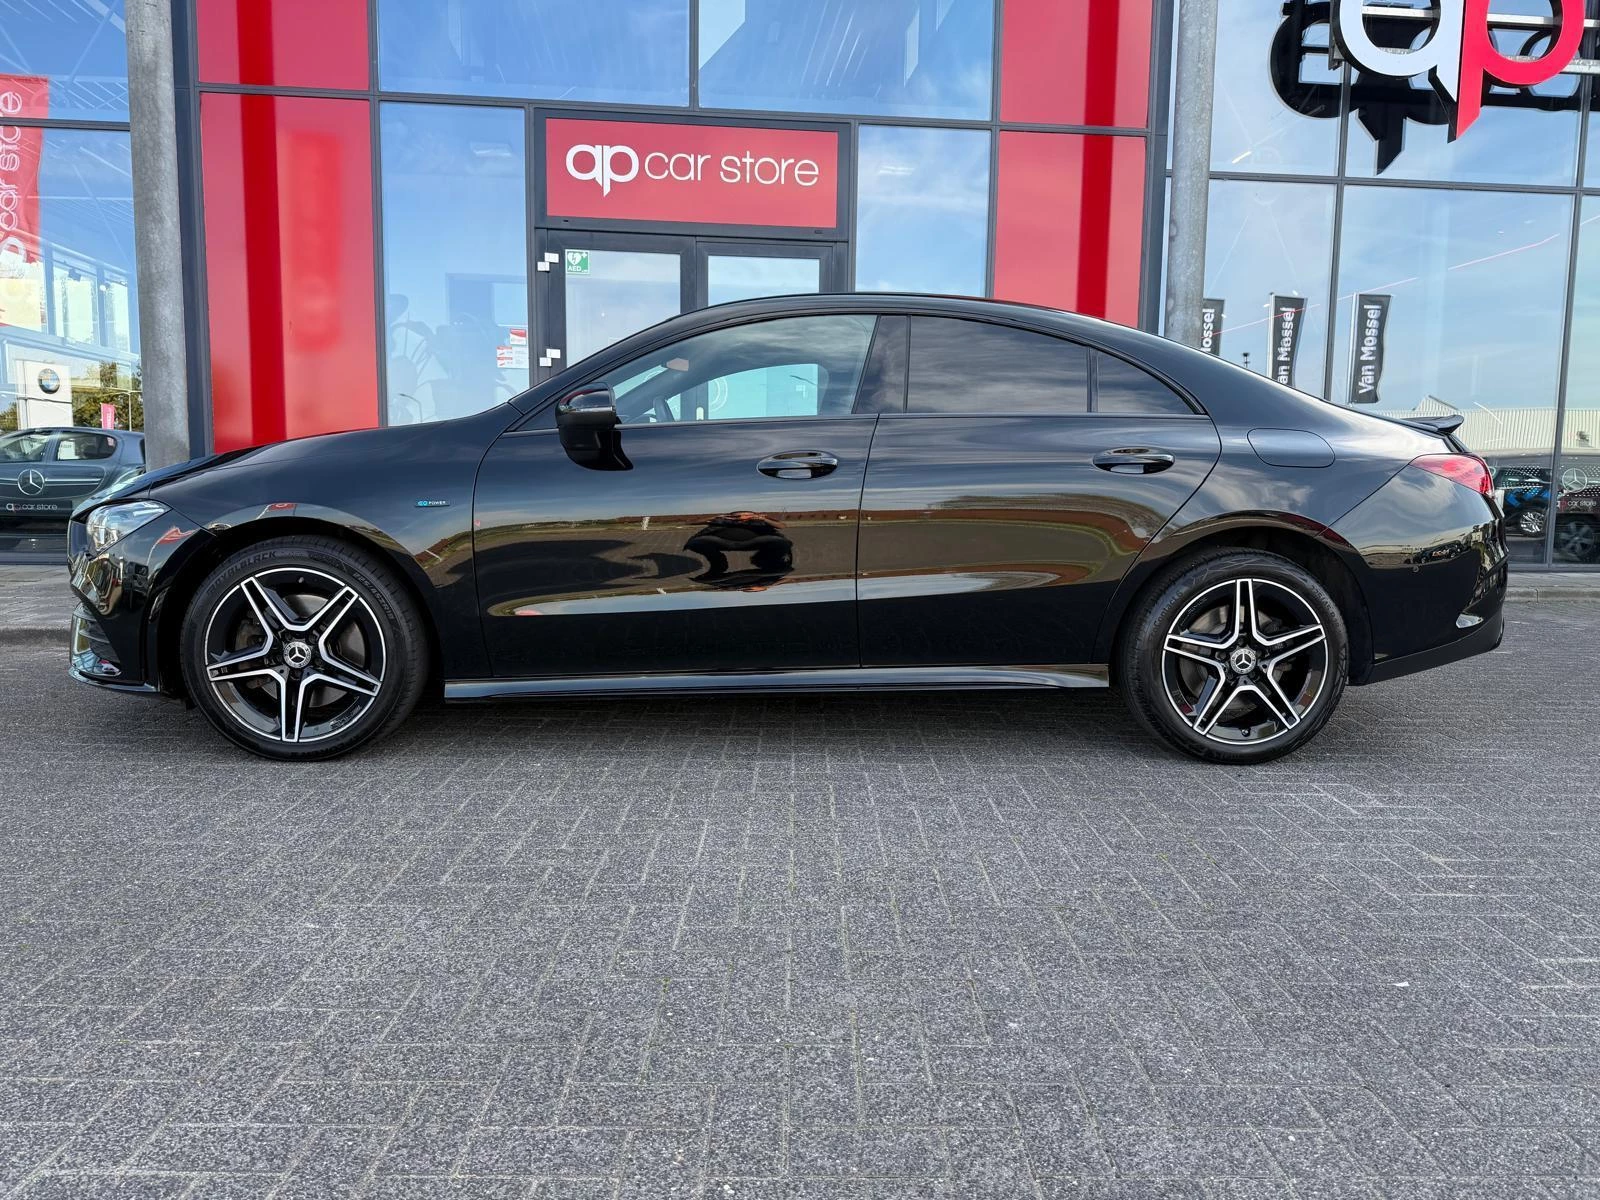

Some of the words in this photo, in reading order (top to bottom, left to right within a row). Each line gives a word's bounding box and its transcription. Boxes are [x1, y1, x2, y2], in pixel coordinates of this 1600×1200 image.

[0, 91, 22, 171] stoe
[565, 143, 640, 197] ap
[644, 150, 712, 182] car
[719, 149, 820, 187] store
[1201, 308, 1215, 352] ossel
[1278, 307, 1296, 361] Mossel
[1360, 304, 1382, 360] Mossel
[1277, 365, 1289, 385] an
[1358, 365, 1375, 394] Van
